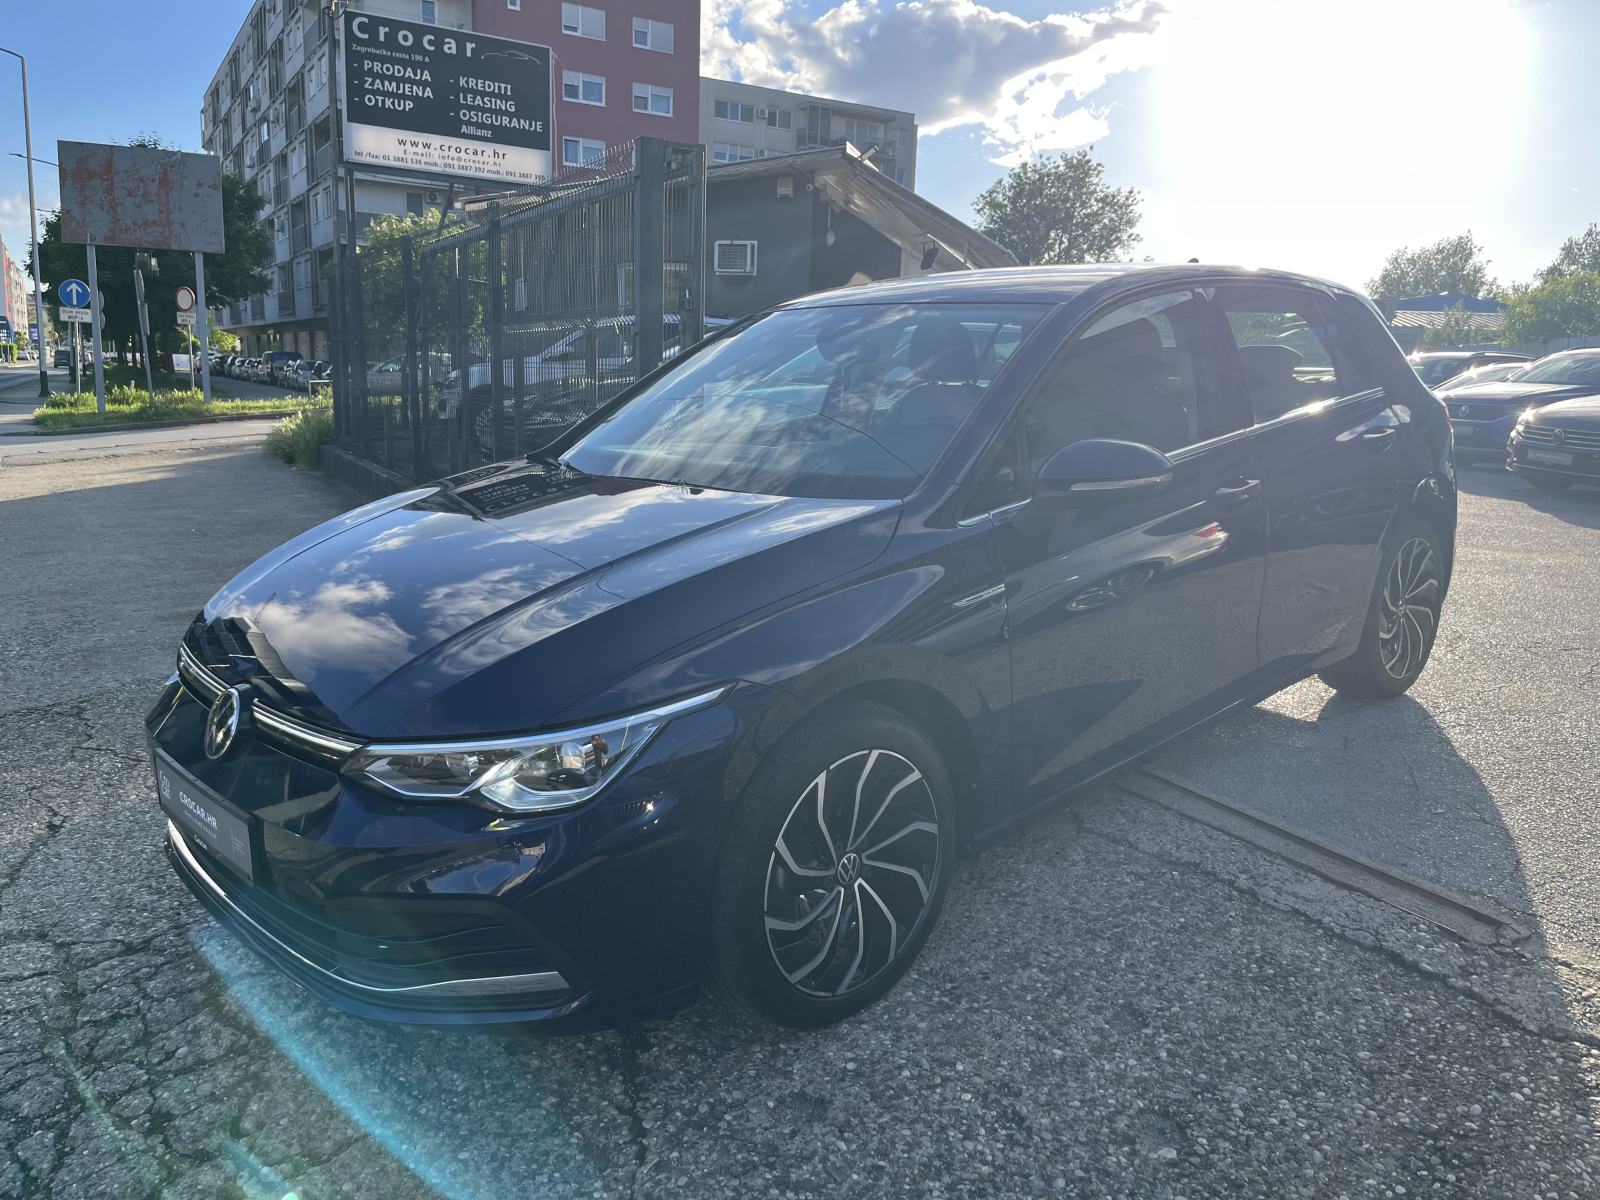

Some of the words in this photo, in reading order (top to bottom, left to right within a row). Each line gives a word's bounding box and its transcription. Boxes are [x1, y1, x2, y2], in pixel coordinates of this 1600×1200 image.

[352, 16, 476, 58] Crocar
[352, 43, 391, 57] Zagrebačka
[392, 51, 410, 60] cesta
[411, 53, 424, 62] 190
[364, 60, 432, 82] PRODAJA
[364, 77, 434, 99] ZAMJENA
[459, 76, 512, 96] KREDITI
[364, 94, 414, 112] OTKUP
[459, 92, 516, 112] LEASING
[459, 109, 543, 132] OSIGURANJE
[460, 124, 493, 138] Allianz
[397, 137, 508, 160] www.crocar.hr
[438, 153, 502, 168] info@crocar.hr
[443, 162, 456, 170] 091
[179, 791, 218, 830] CROCAR.HR
